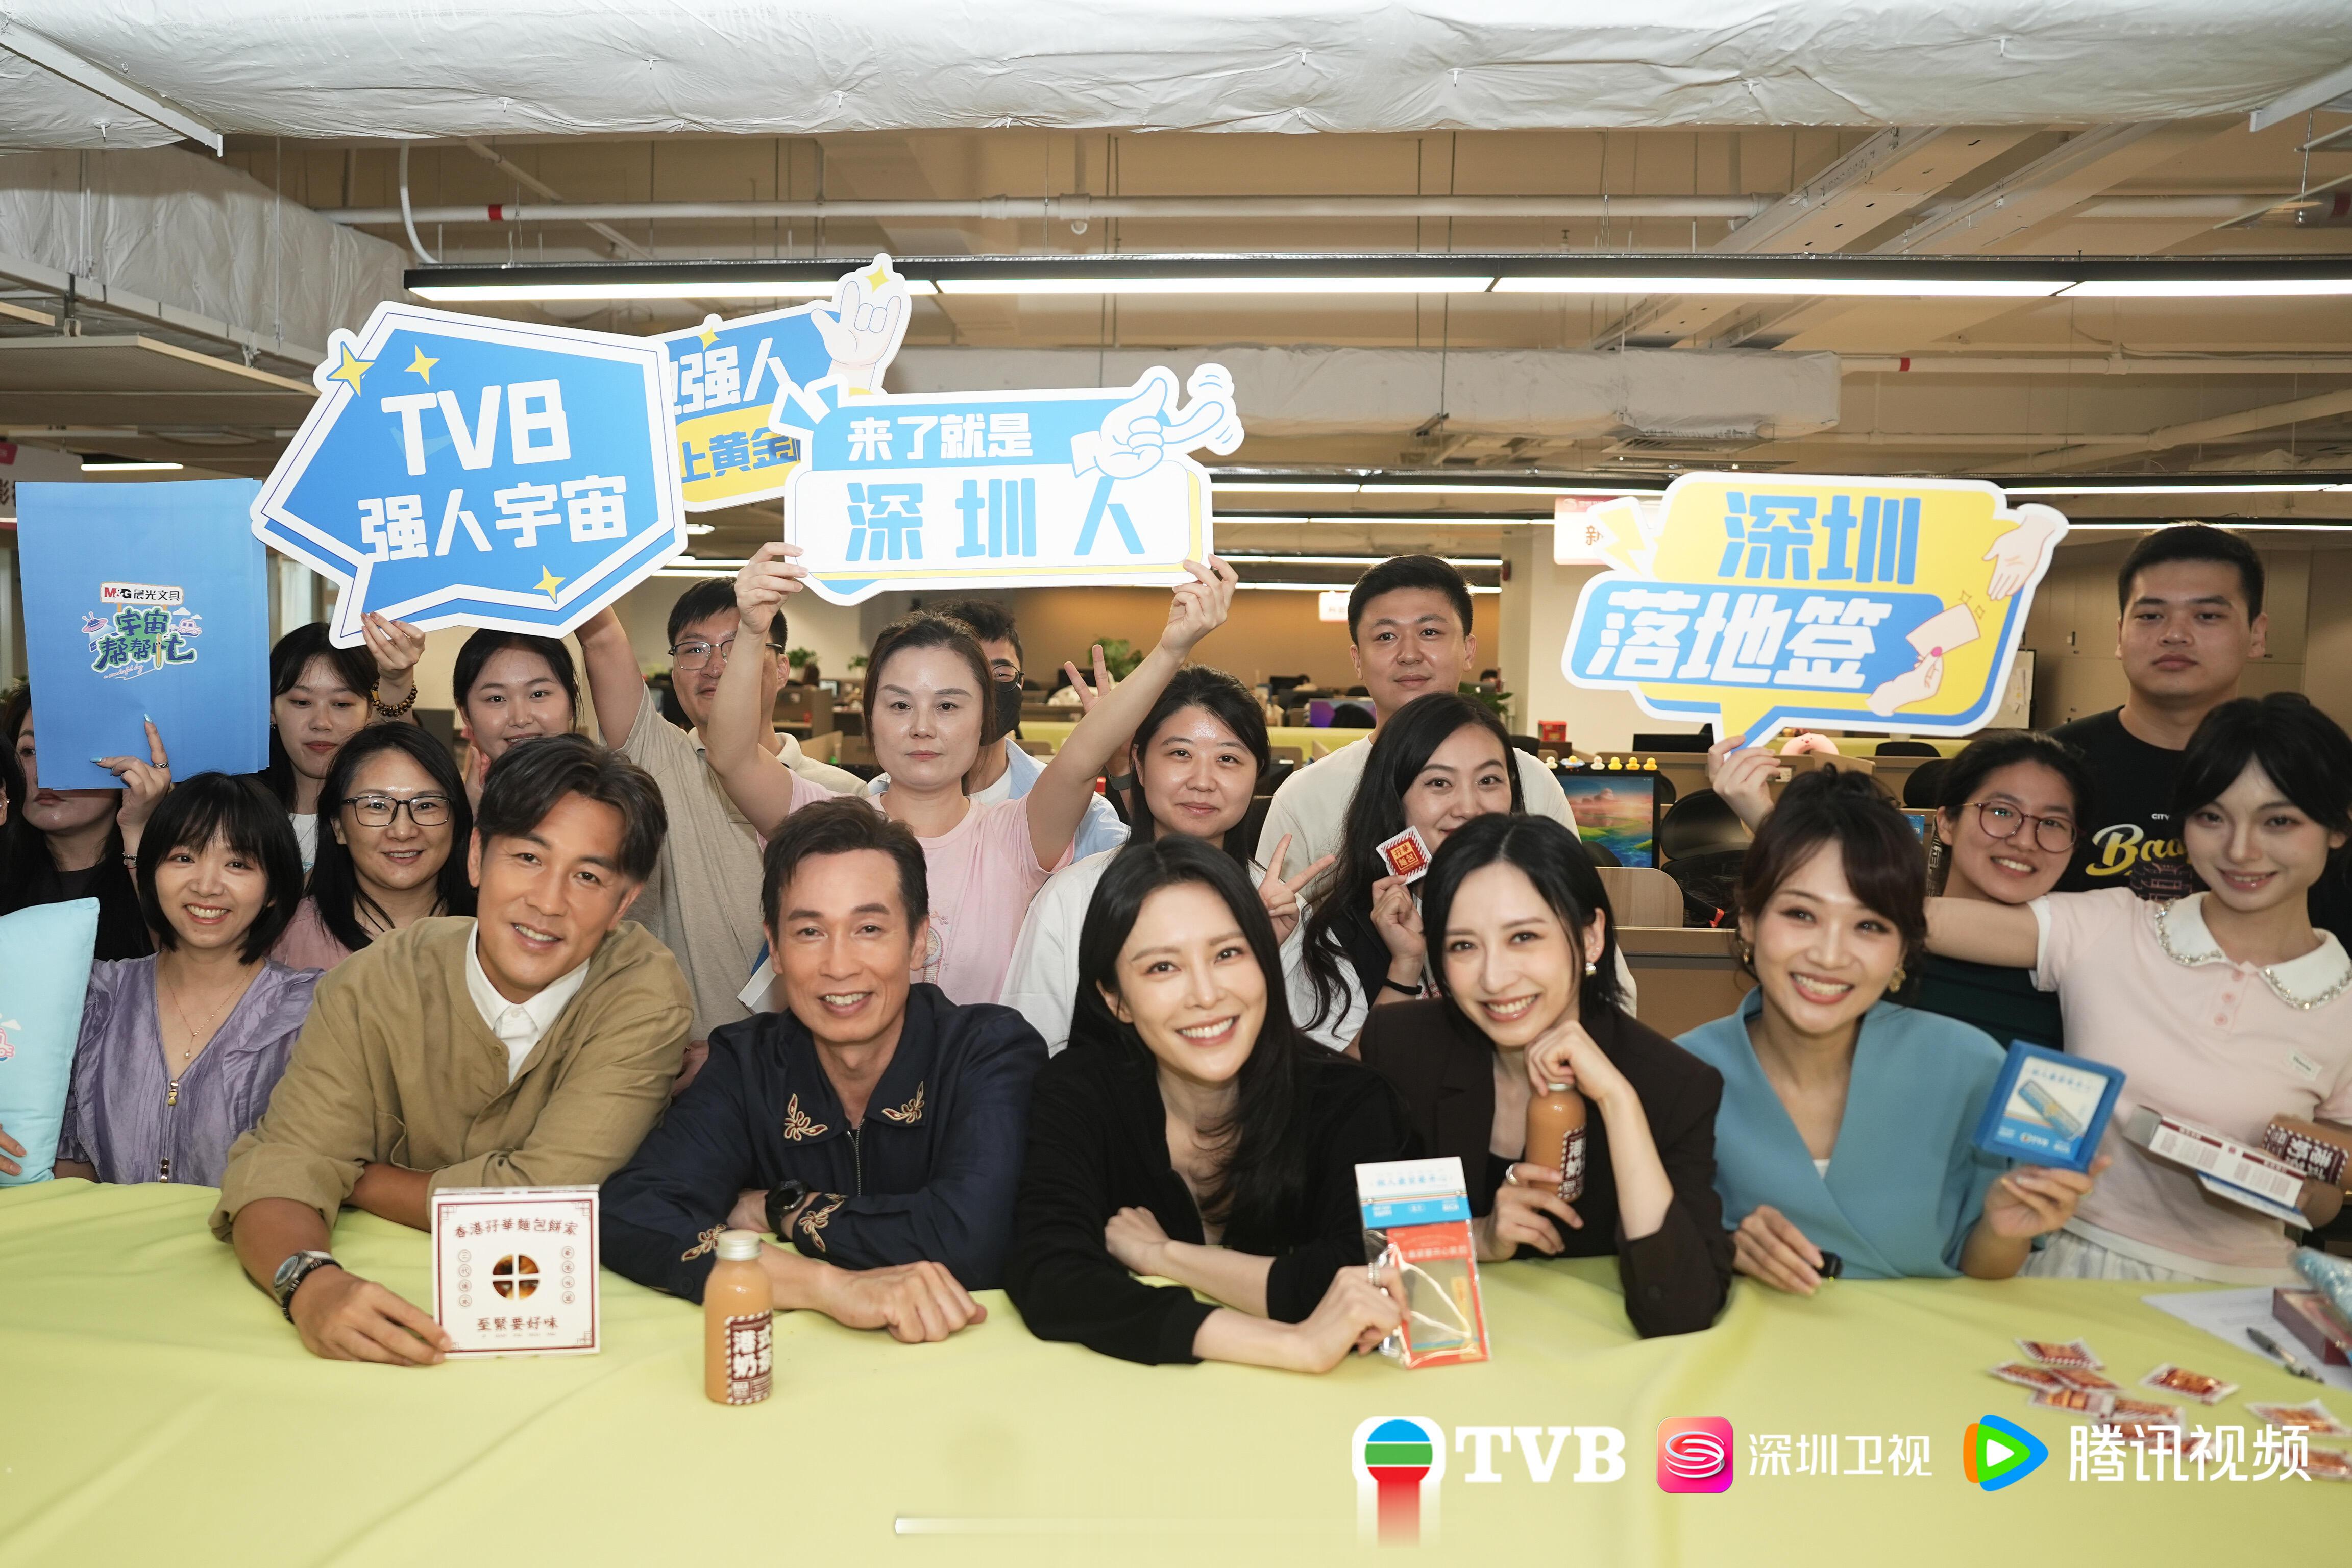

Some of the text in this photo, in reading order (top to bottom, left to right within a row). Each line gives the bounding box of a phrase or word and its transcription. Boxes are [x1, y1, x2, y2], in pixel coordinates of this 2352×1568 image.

[670, 337, 793, 415] 强人
[381, 379, 571, 476] TVB
[681, 427, 800, 483] 上黄金
[848, 412, 1033, 461] 来了就是
[358, 475, 628, 562] 强人宇宙
[845, 477, 1145, 561] 深圳人
[1718, 491, 1921, 585] 深圳
[105, 587, 180, 601] M&G 晨光文具
[117, 609, 168, 636] 宇宙
[95, 634, 194, 669] 帮帮忙
[1585, 589, 1892, 688] 落地签
[477, 1315, 559, 1331] 至緊要好味
